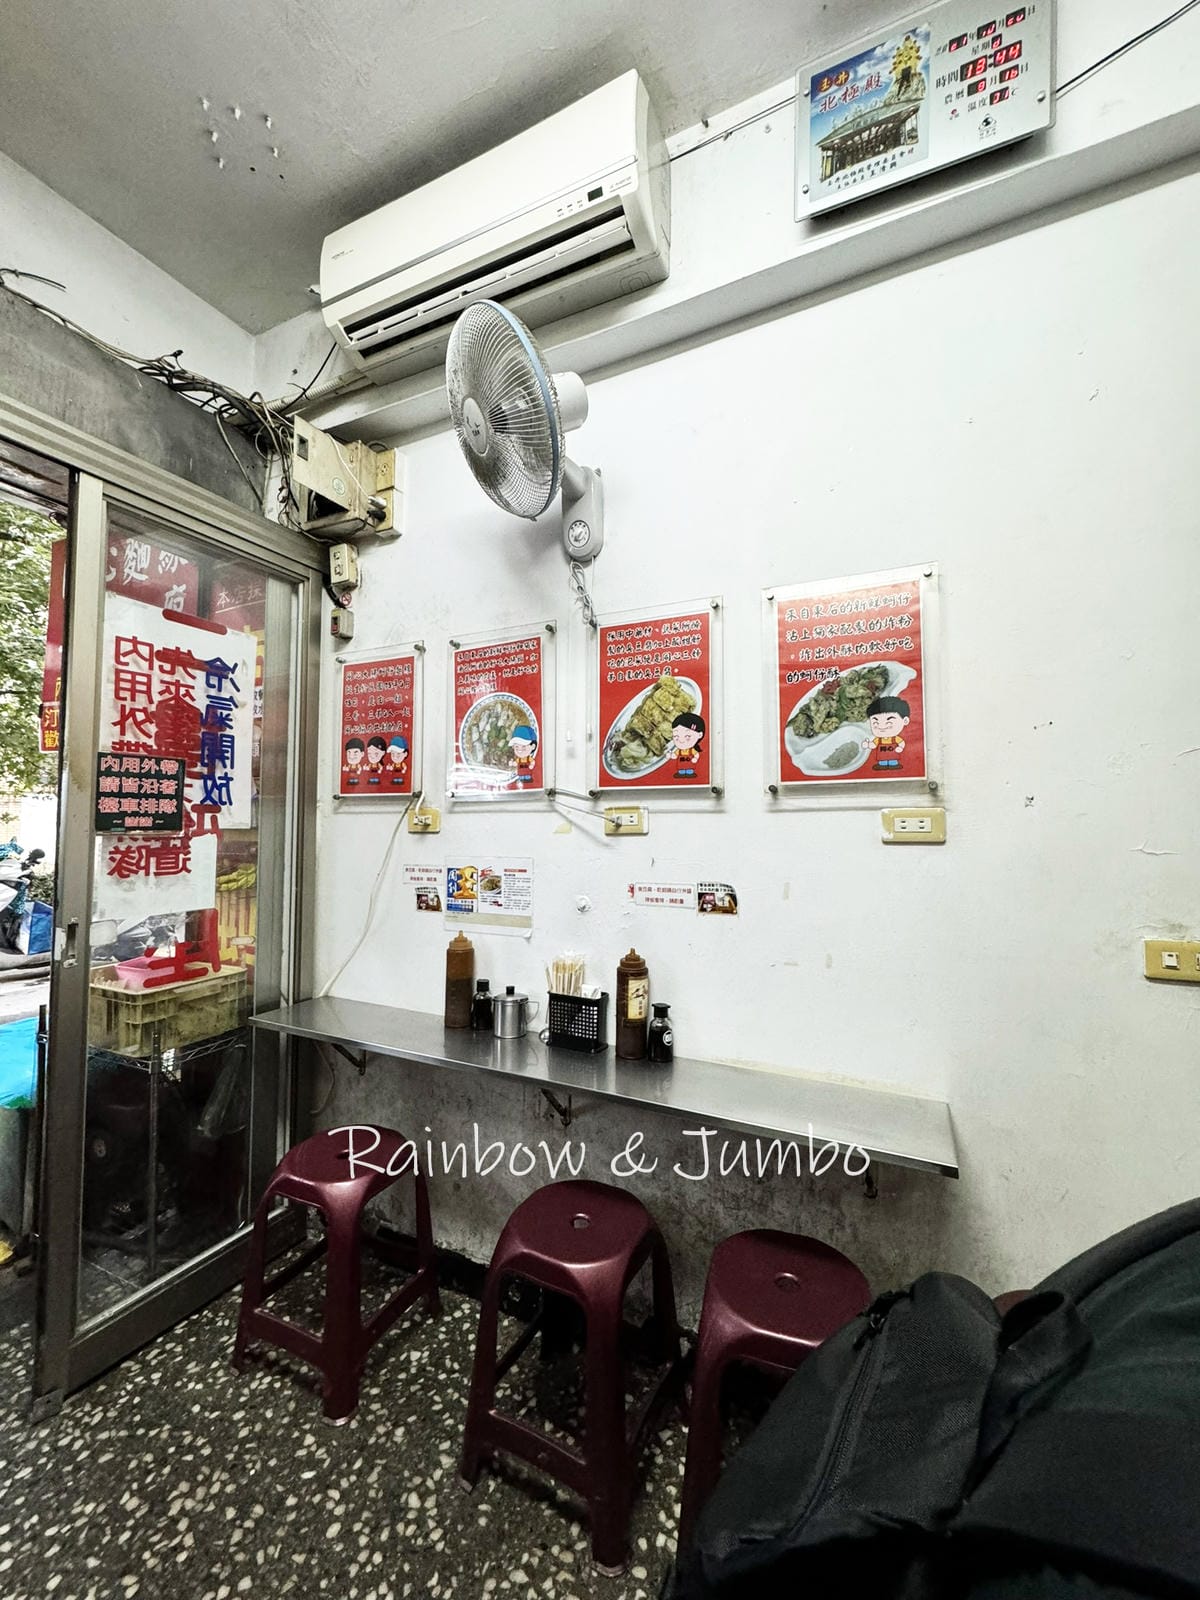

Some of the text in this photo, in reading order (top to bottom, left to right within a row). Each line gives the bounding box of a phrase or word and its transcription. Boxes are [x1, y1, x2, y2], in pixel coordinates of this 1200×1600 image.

[819, 71, 883, 112] 北極殿
[100, 755, 179, 775] 內用外帶
